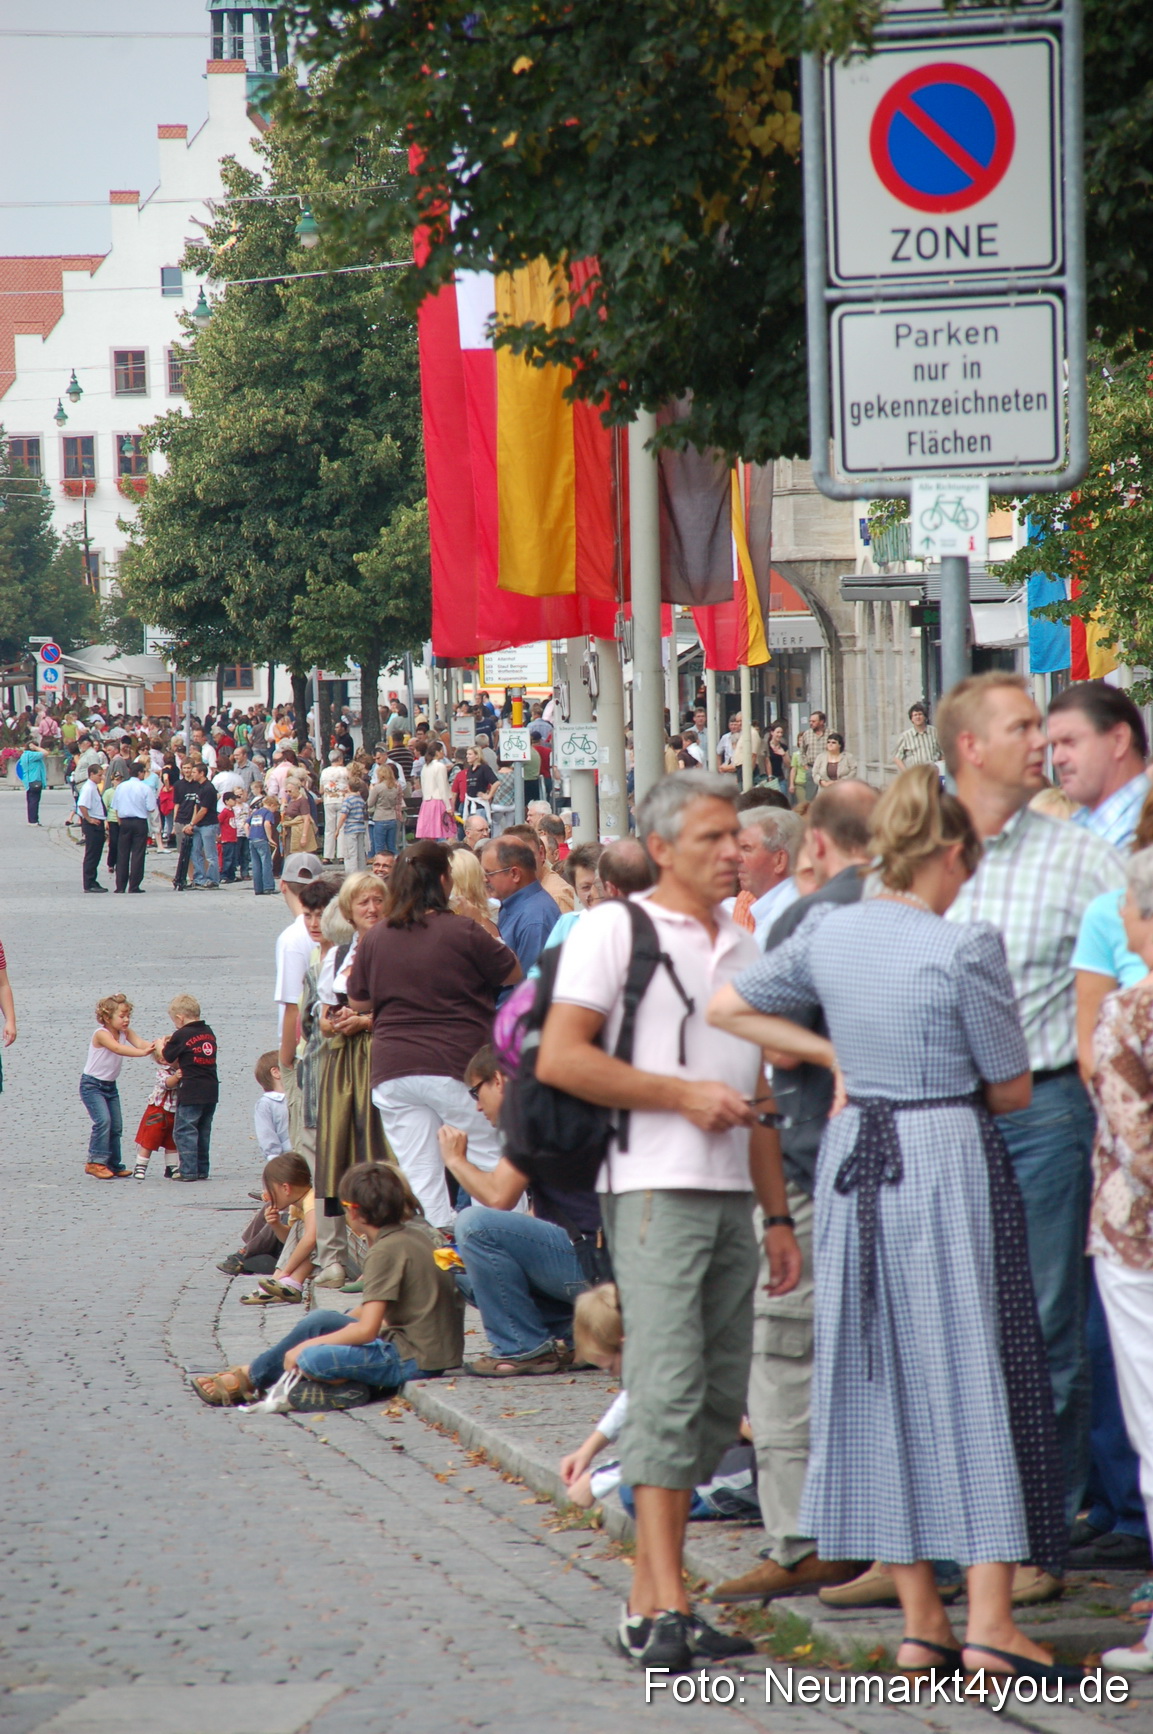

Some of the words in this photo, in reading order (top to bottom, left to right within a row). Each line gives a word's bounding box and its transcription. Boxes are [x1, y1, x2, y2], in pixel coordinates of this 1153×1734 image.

[891, 222, 999, 262] ZONE
[895, 322, 998, 348] Parken
[914, 361, 948, 381] nur
[963, 356, 981, 379] in
[850, 389, 1048, 427] gekennzeichneten
[907, 430, 991, 455] Flächen
[936, 482, 980, 493] Richtungen
